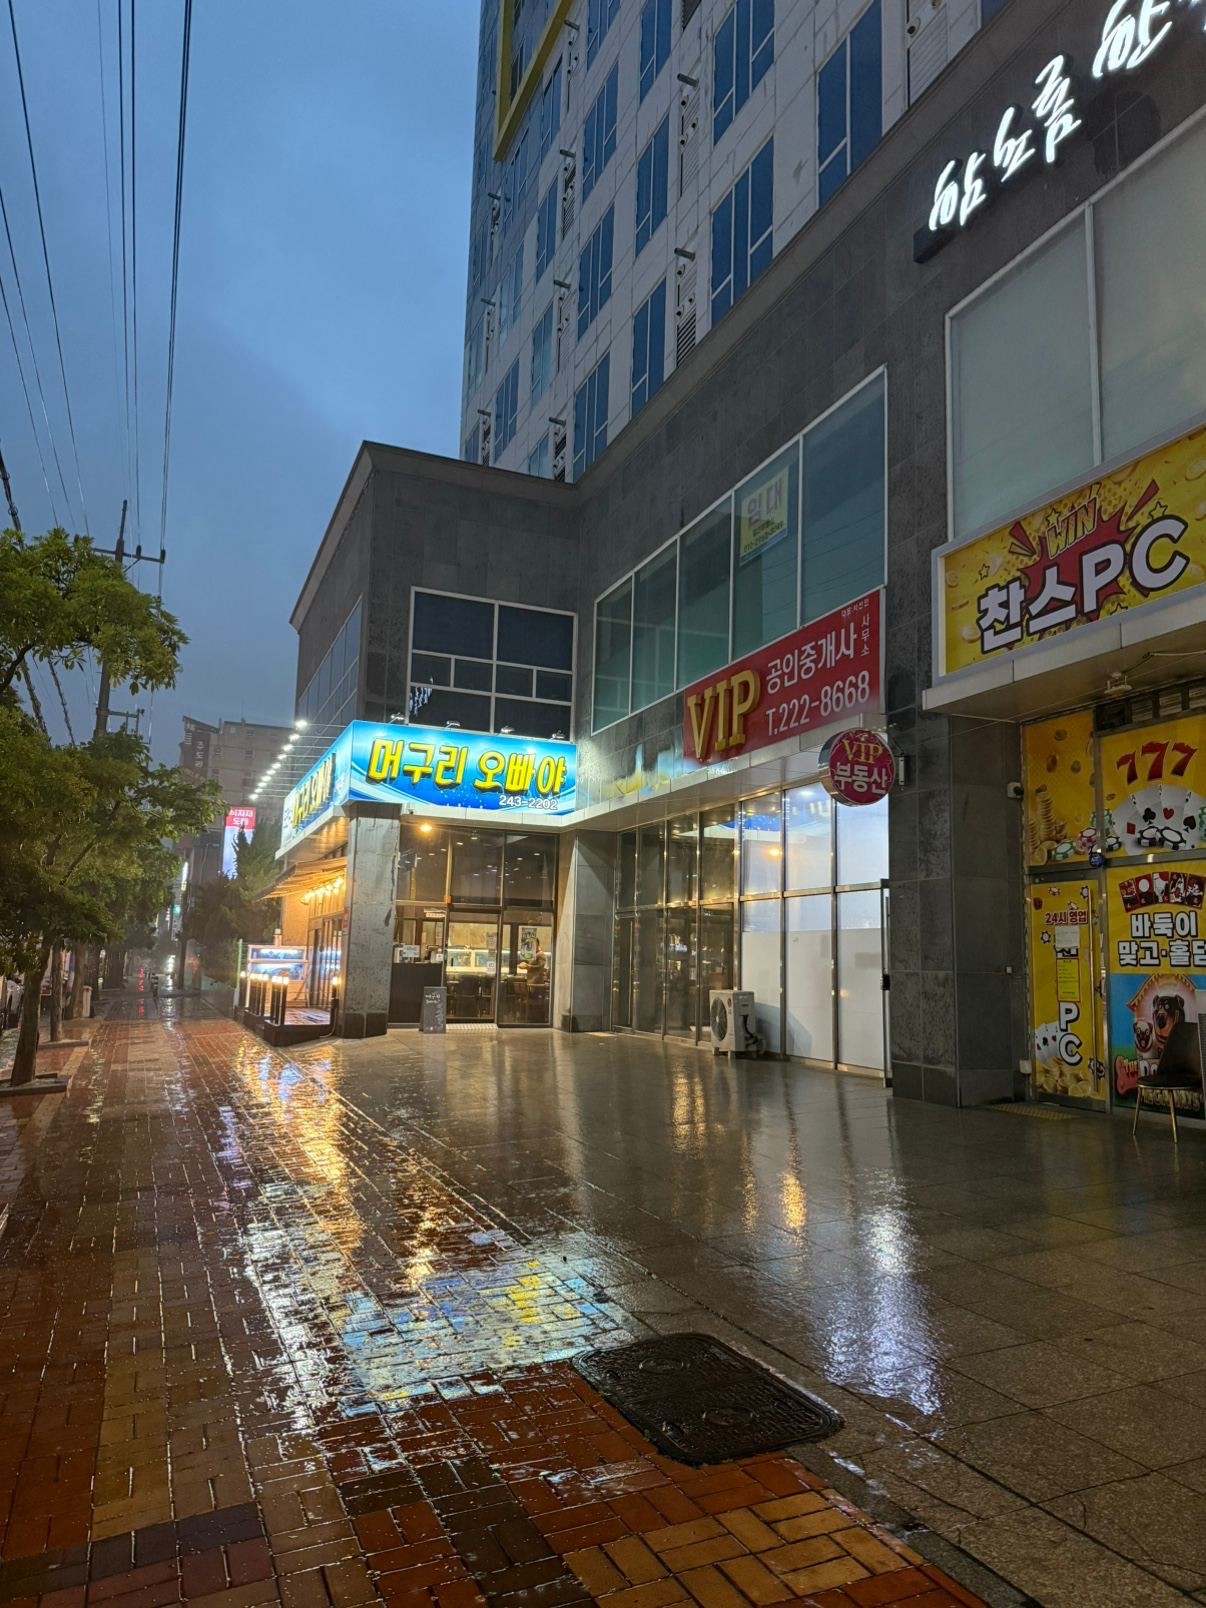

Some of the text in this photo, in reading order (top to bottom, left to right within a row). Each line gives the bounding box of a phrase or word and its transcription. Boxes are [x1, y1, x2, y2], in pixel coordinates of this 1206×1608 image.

[747, 477, 783, 529] 임대
[1046, 495, 1099, 559] WIN
[860, 612, 871, 657] 사무소
[765, 622, 857, 694] 공인중개사
[687, 669, 761, 761] VIP
[765, 670, 870, 737] T.222-8668
[366, 737, 470, 790] 머구리
[473, 751, 567, 796] 오빠야
[842, 739, 883, 764] VIP
[1116, 740, 1199, 786] 777
[834, 761, 888, 795] 부동산
[498, 794, 559, 811] 243-2202
[1045, 910, 1088, 925] 24시 영업
[1129, 910, 1199, 939] 바둑이
